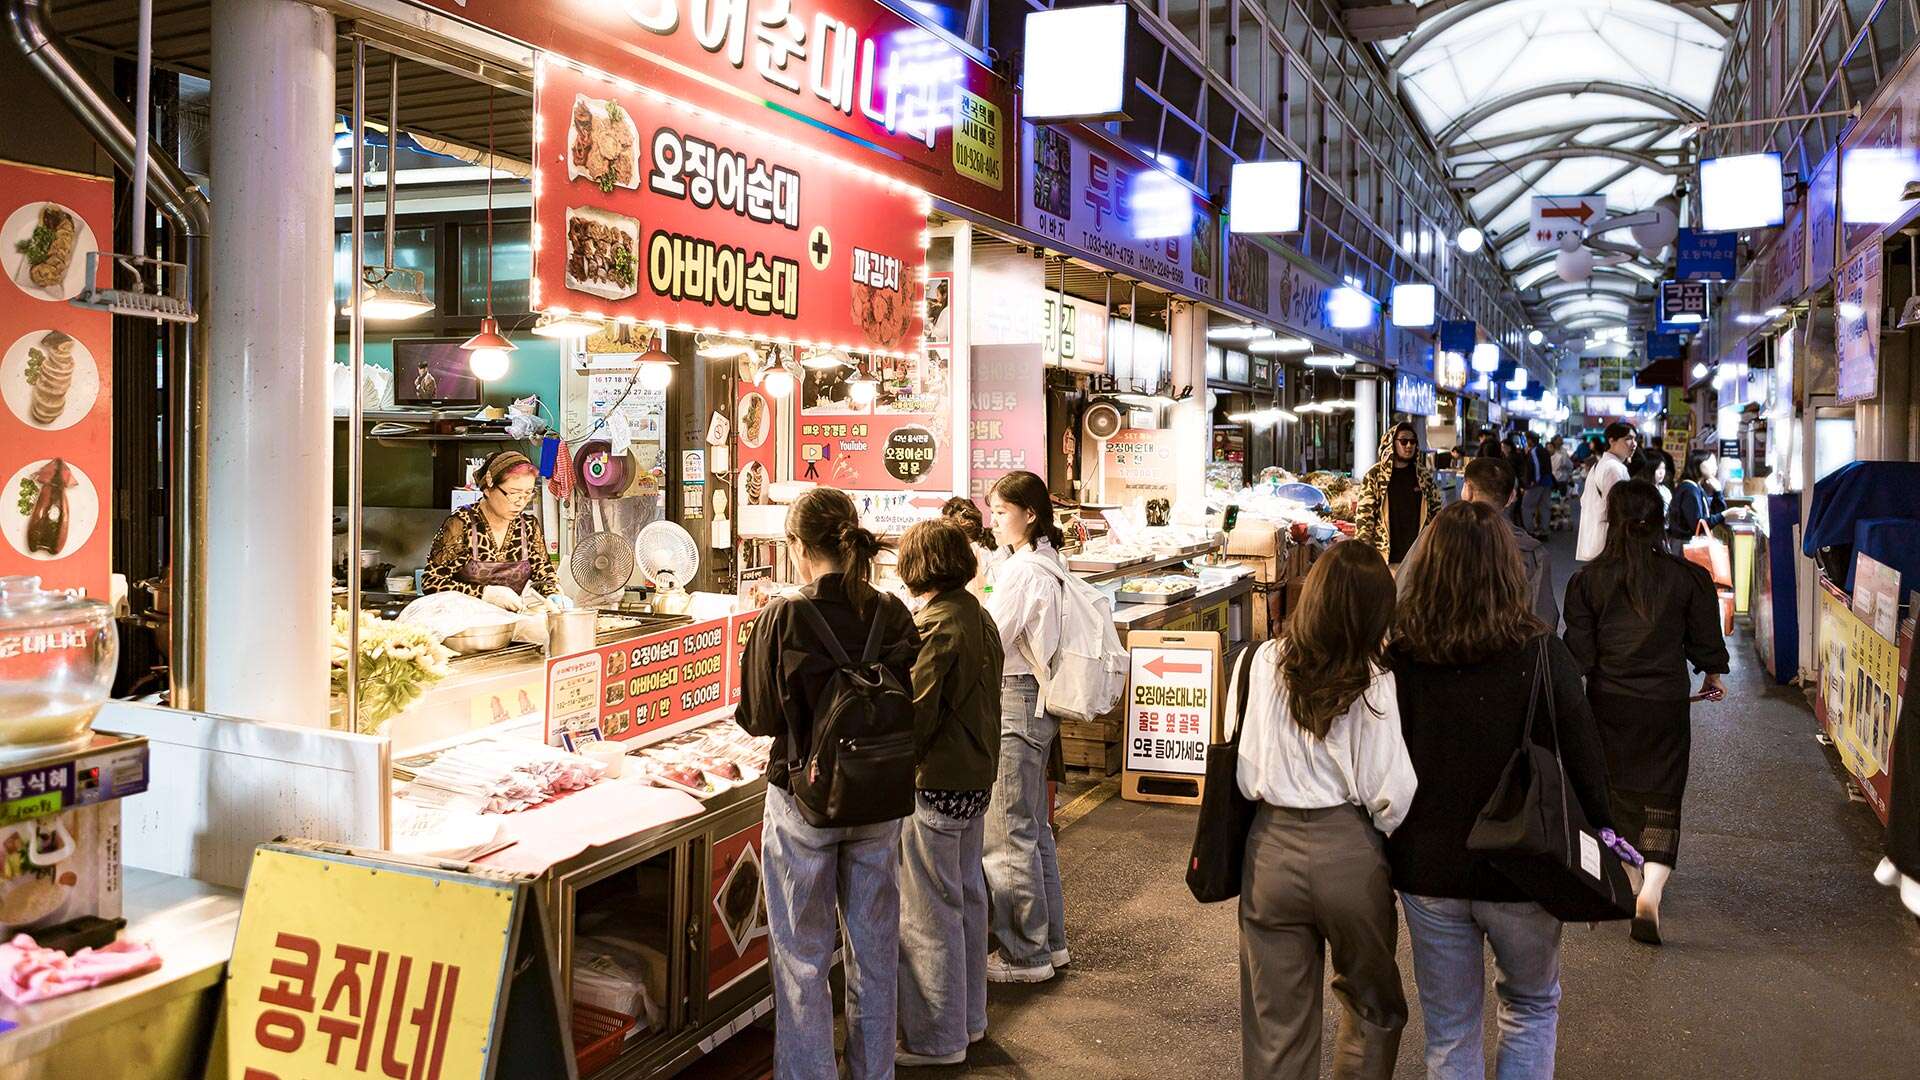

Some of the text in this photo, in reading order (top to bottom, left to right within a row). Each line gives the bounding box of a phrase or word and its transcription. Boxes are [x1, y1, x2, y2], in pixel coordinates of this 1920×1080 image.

[651, 128, 799, 229] 오징어순대
[650, 231, 798, 318] 아바이순대
[851, 247, 900, 292] 파김치
[839, 440, 868, 451] YouTube
[886, 447, 933, 460] 오징어순대
[630, 638, 679, 669] 오징어순대
[683, 627, 722, 655] 15,000원
[629, 665, 679, 697] 아바이순대
[682, 654, 721, 682] 15,000원
[1135, 685, 1207, 708] 오징어순대나라
[635, 703, 648, 726] 반
[659, 696, 671, 717] 반
[680, 681, 720, 711] 15,000원
[1133, 737, 1204, 761] 으로 들어가세요
[255, 931, 461, 1080] 콩쥐네
